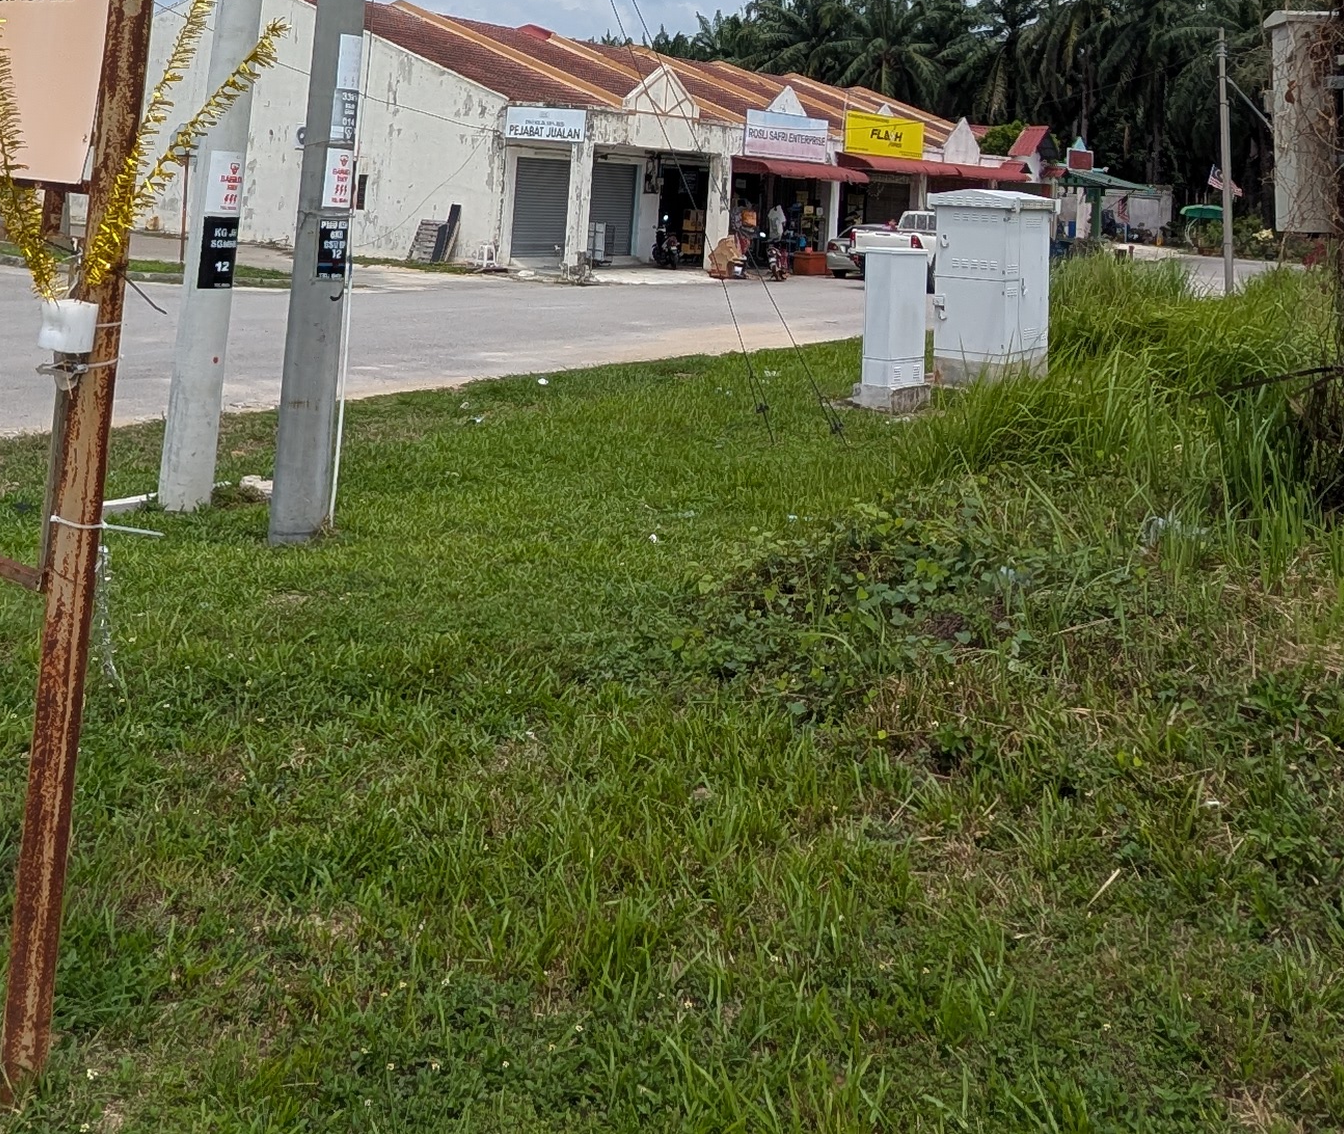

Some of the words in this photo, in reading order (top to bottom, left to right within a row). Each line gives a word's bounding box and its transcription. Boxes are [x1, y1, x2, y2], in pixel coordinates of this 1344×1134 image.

[509, 125, 544, 137] PEJABAT
[546, 127, 581, 139] JUALAN
[748, 128, 768, 140] ROSLI
[788, 133, 826, 146] ENTERPRISE
[332, 249, 342, 259] 12
[215, 261, 230, 272] 12
